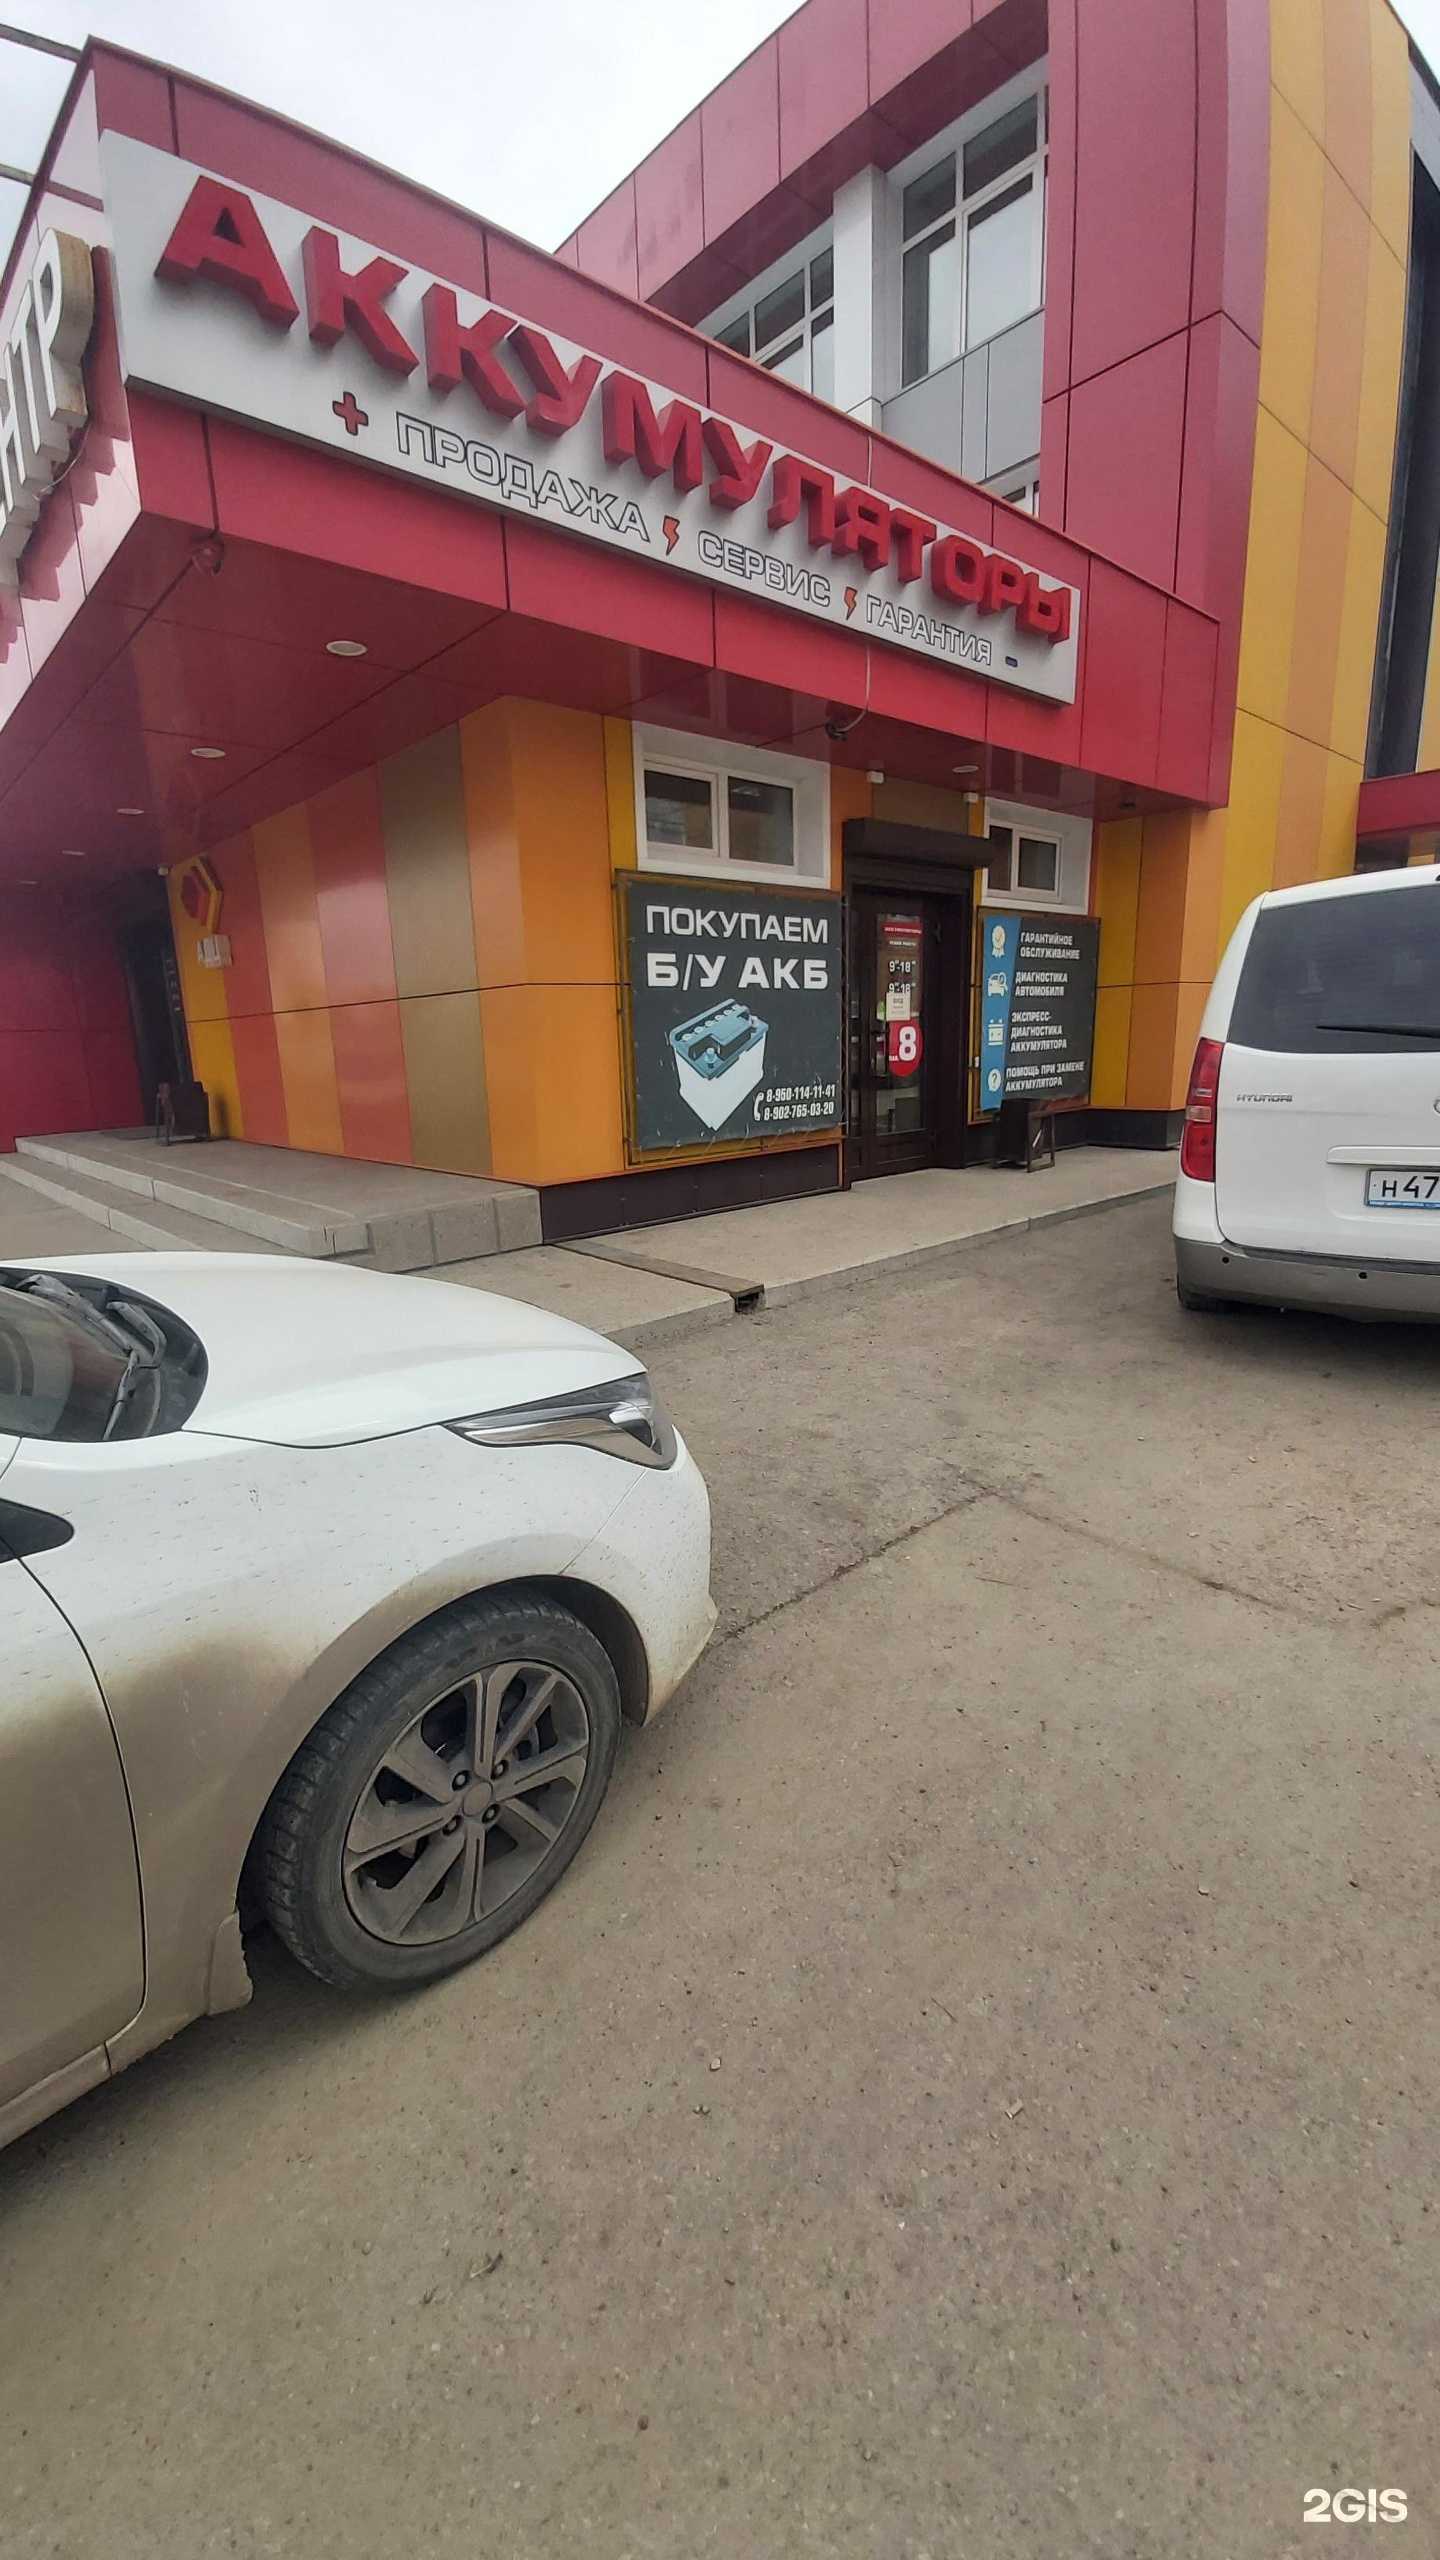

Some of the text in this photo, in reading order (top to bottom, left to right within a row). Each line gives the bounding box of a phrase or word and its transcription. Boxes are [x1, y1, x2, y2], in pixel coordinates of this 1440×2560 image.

[155, 175, 1071, 645] АККУМУЛЯТОРЫ
[396, 410, 992, 666] ПРОДАЖА СЕРВИС ГАРАНТИЯ
[646, 905, 829, 944] ПОКУПАЕМ
[1020, 932, 1073, 946] ГАРАНТИЙНОЕ
[1020, 946, 1081, 960] ОБСЛУЖИВАНИЕ
[647, 952, 829, 991] Б/У АКБ
[1015, 971, 1068, 984] ДИАГНОСТИКА
[1015, 985, 1065, 997] АВТОМОБИЛЯ
[1010, 1025, 1063, 1040] ДИАГНОСТИКА
[1010, 1039, 1067, 1053] АККУМУЛЯТОРА
[1006, 1061, 1085, 1079] ПОМОЩЬ ПРИ ЗАМЕНЕ
[1005, 1077, 1063, 1092] АККУМУЛЯТОРА
[1236, 1093, 1294, 1103] HYUNDAI
[764, 1101, 835, 1121] 8-902-765-03-20
